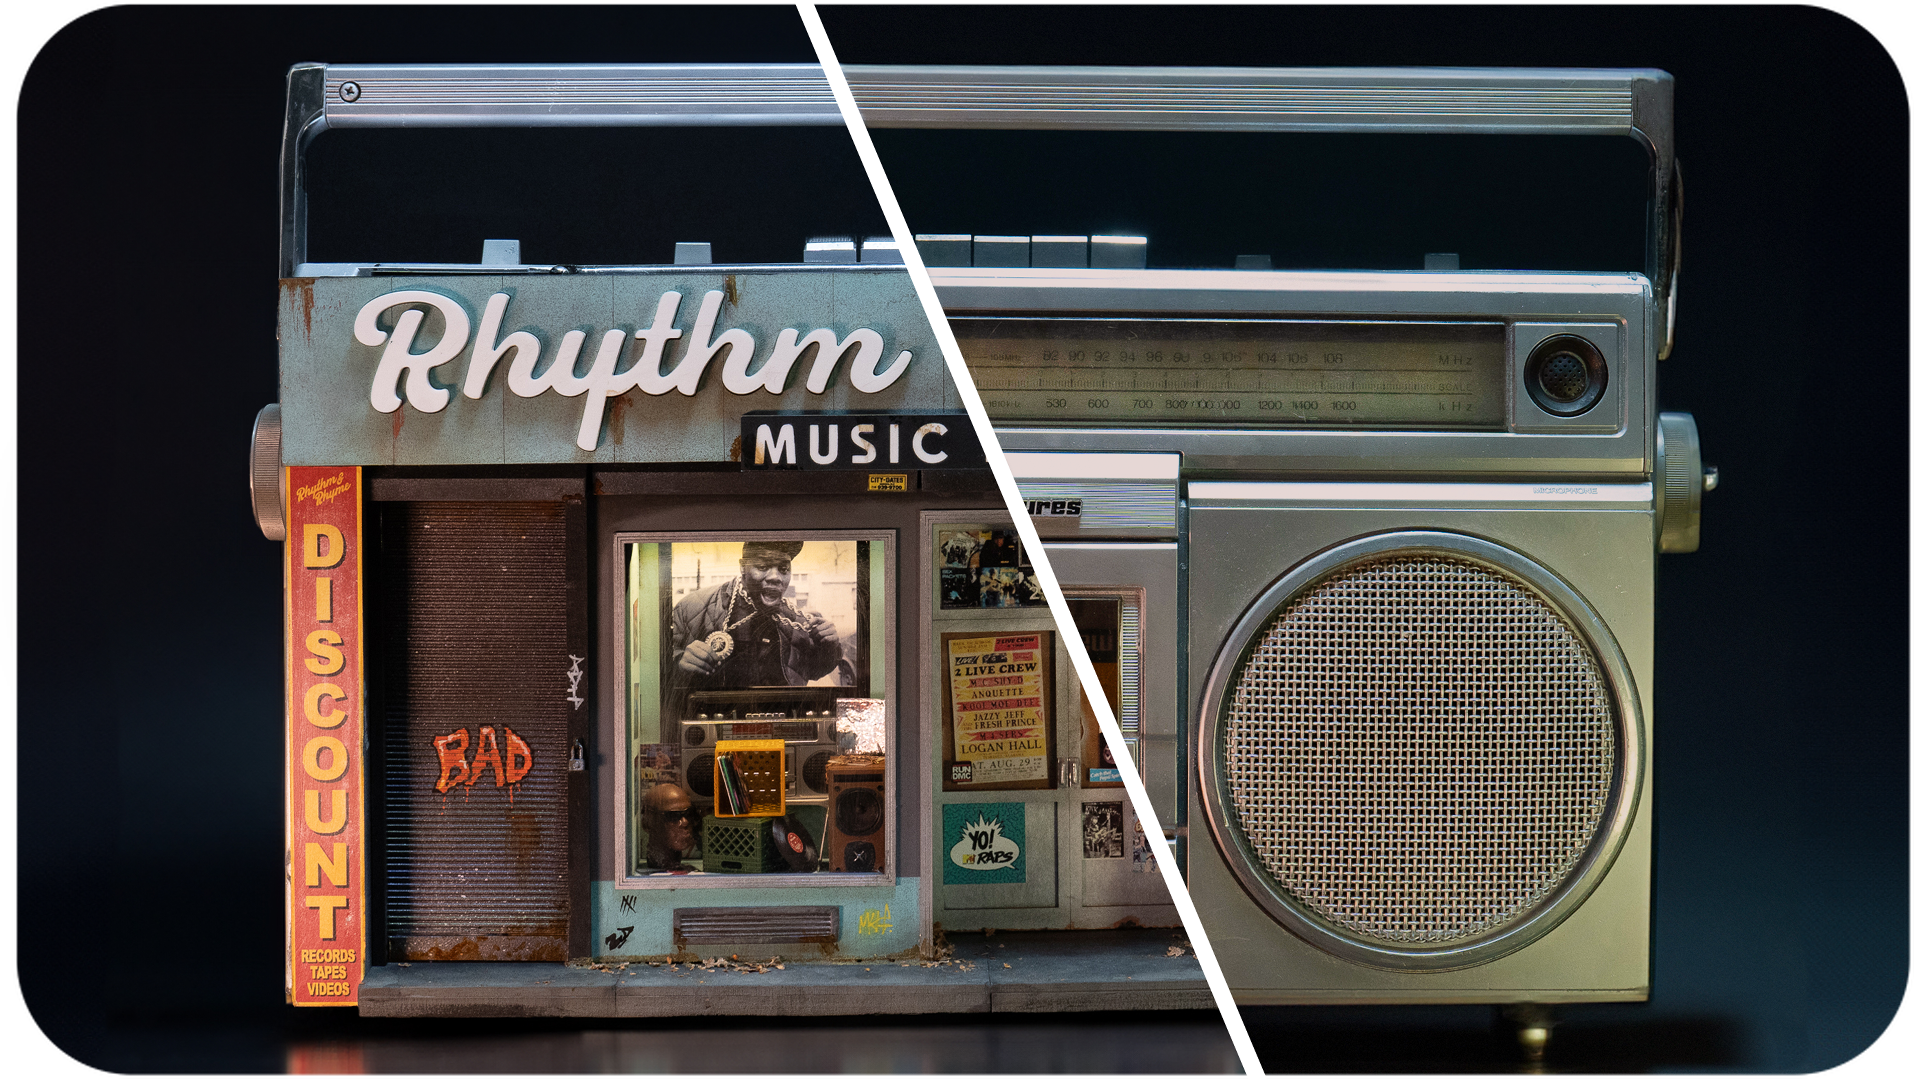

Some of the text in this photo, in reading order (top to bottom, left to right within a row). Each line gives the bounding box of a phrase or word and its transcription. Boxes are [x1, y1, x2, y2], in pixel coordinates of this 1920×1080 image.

[1069, 350, 1085, 361] 90
[1094, 350, 1110, 361] 92
[1120, 351, 1135, 362] 94
[1146, 351, 1163, 362] 96
[1258, 353, 1276, 363] 104
[1324, 353, 1343, 363] 108
[354, 291, 912, 452] Rhythm
[1046, 399, 1067, 408] 530
[1088, 399, 1109, 408] 600
[1133, 399, 1153, 409] 700
[1259, 400, 1282, 410] 1200
[1332, 400, 1357, 410] 1600
[754, 423, 949, 465] MUSIC
[296, 477, 338, 502] Rhythm
[315, 482, 351, 506] Rhyme
[1533, 487, 1598, 495] MICROPHONE
[955, 663, 1037, 676] 2 LIVE CREW
[972, 688, 1024, 699] ANQUETTE
[974, 710, 1025, 722] JAZZY JEFF
[975, 720, 1002, 730] FRESH
[1006, 718, 1037, 727] PRINCE
[303, 524, 349, 941] DISCOUNT
[961, 742, 1003, 754] LOGAN
[1009, 740, 1042, 750] HALL
[433, 725, 533, 794] BAD
[971, 762, 986, 770] AT.
[990, 760, 1016, 769] AUG.
[1020, 758, 1031, 767] 29
[968, 828, 995, 851] YO!
[977, 851, 1013, 865] RAPS
[301, 949, 356, 963] RECORDS
[310, 965, 347, 980] TAPES
[307, 982, 350, 997] VIDEOS
